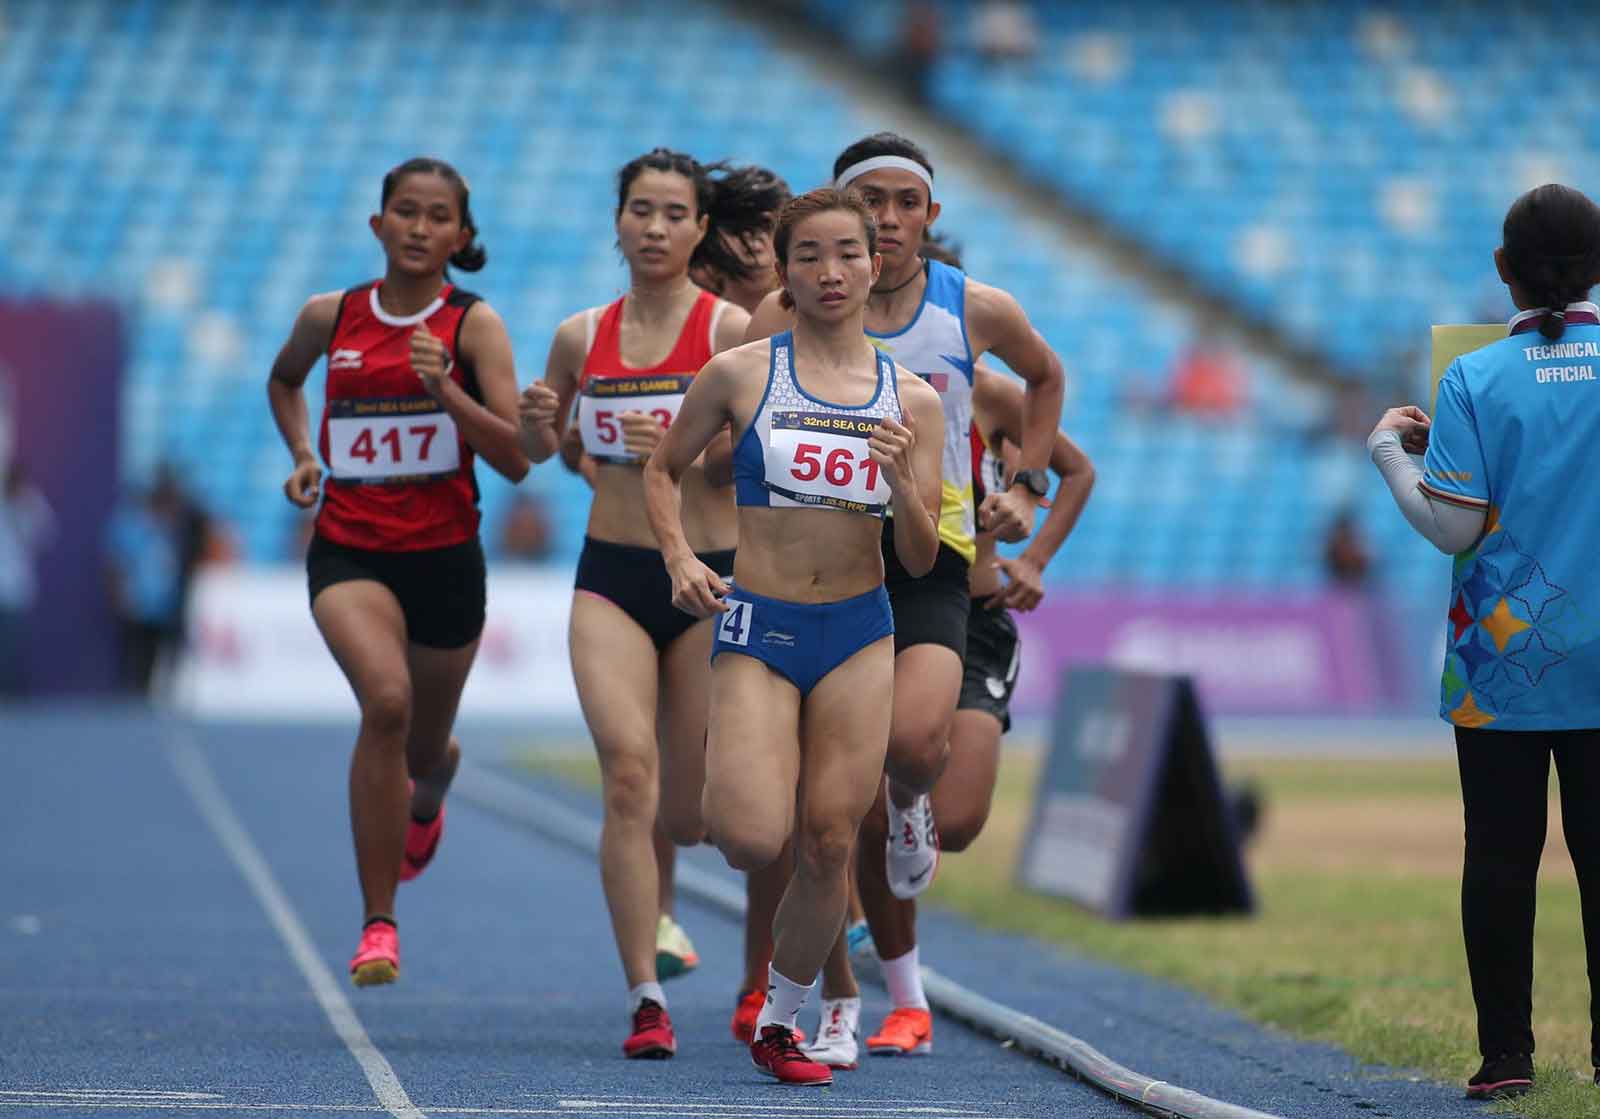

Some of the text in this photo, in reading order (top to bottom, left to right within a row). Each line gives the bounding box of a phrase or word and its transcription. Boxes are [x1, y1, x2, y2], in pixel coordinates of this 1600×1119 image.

[1522, 342, 1600, 360] TECHNICAL
[1536, 365, 1597, 383] OFFICIAL
[803, 417, 830, 428] 32nd
[832, 420, 855, 431] SEA
[350, 424, 438, 464] 417
[790, 443, 879, 491] 561
[723, 603, 744, 642] 4
